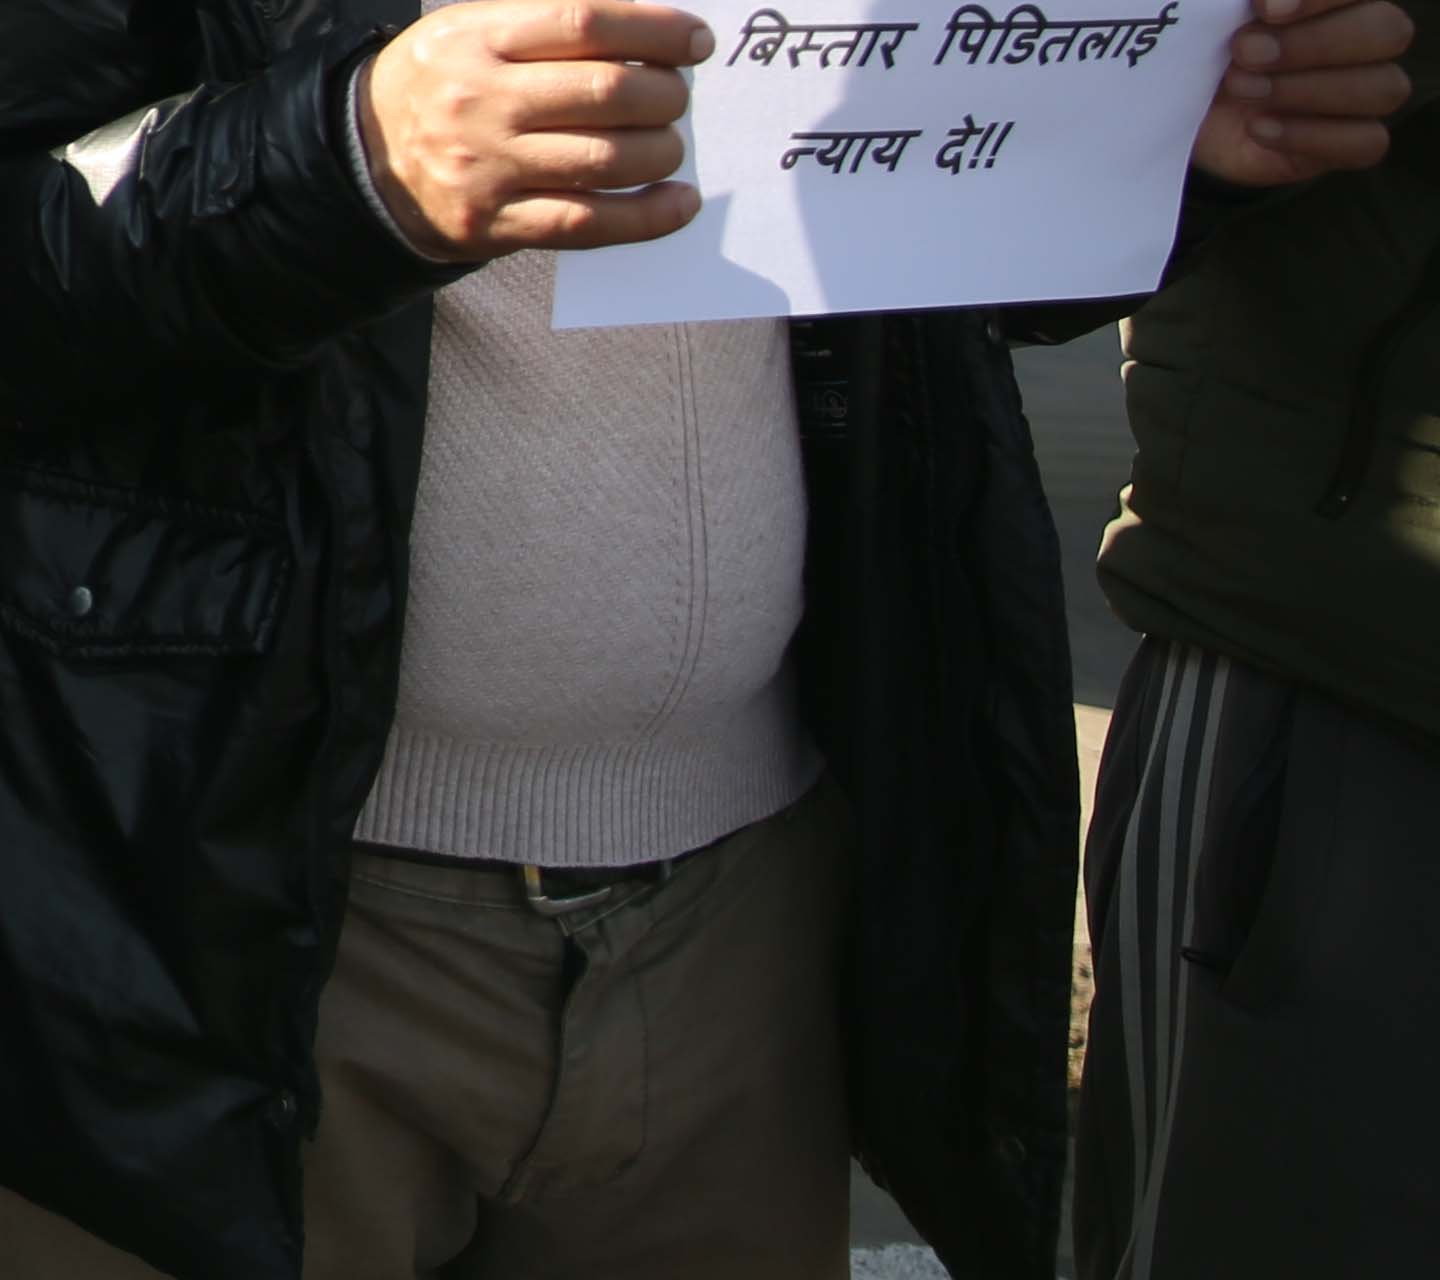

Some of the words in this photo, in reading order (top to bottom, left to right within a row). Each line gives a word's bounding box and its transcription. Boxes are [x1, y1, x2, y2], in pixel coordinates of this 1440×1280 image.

[726, 9, 920, 70] बिस्तार
[934, 1, 1179, 68] पिडितलाई
[781, 130, 923, 174] न्याय
[935, 114, 1015, 175] दे!!
